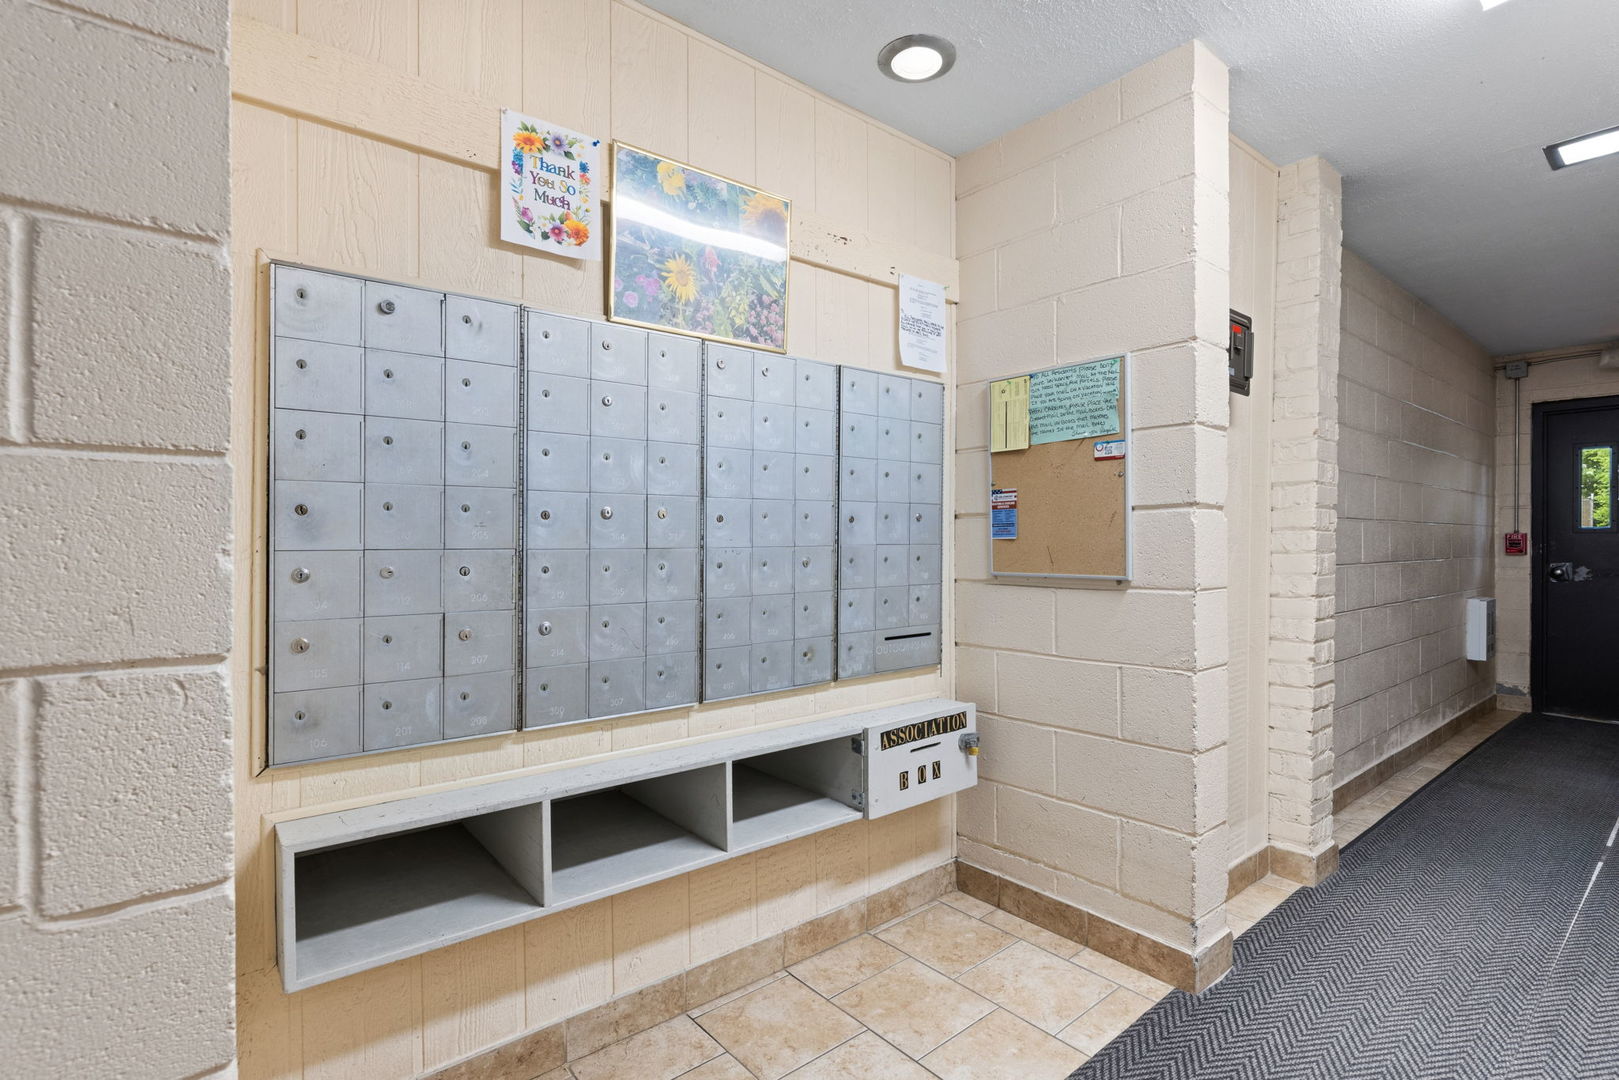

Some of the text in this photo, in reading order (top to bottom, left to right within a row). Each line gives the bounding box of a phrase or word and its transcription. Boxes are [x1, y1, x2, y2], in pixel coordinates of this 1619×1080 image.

[529, 156, 575, 181] Thank
[529, 170, 576, 196] You So
[534, 188, 571, 211] Much
[395, 727, 412, 737] 201
[881, 711, 967, 751] ASSOCIATION
